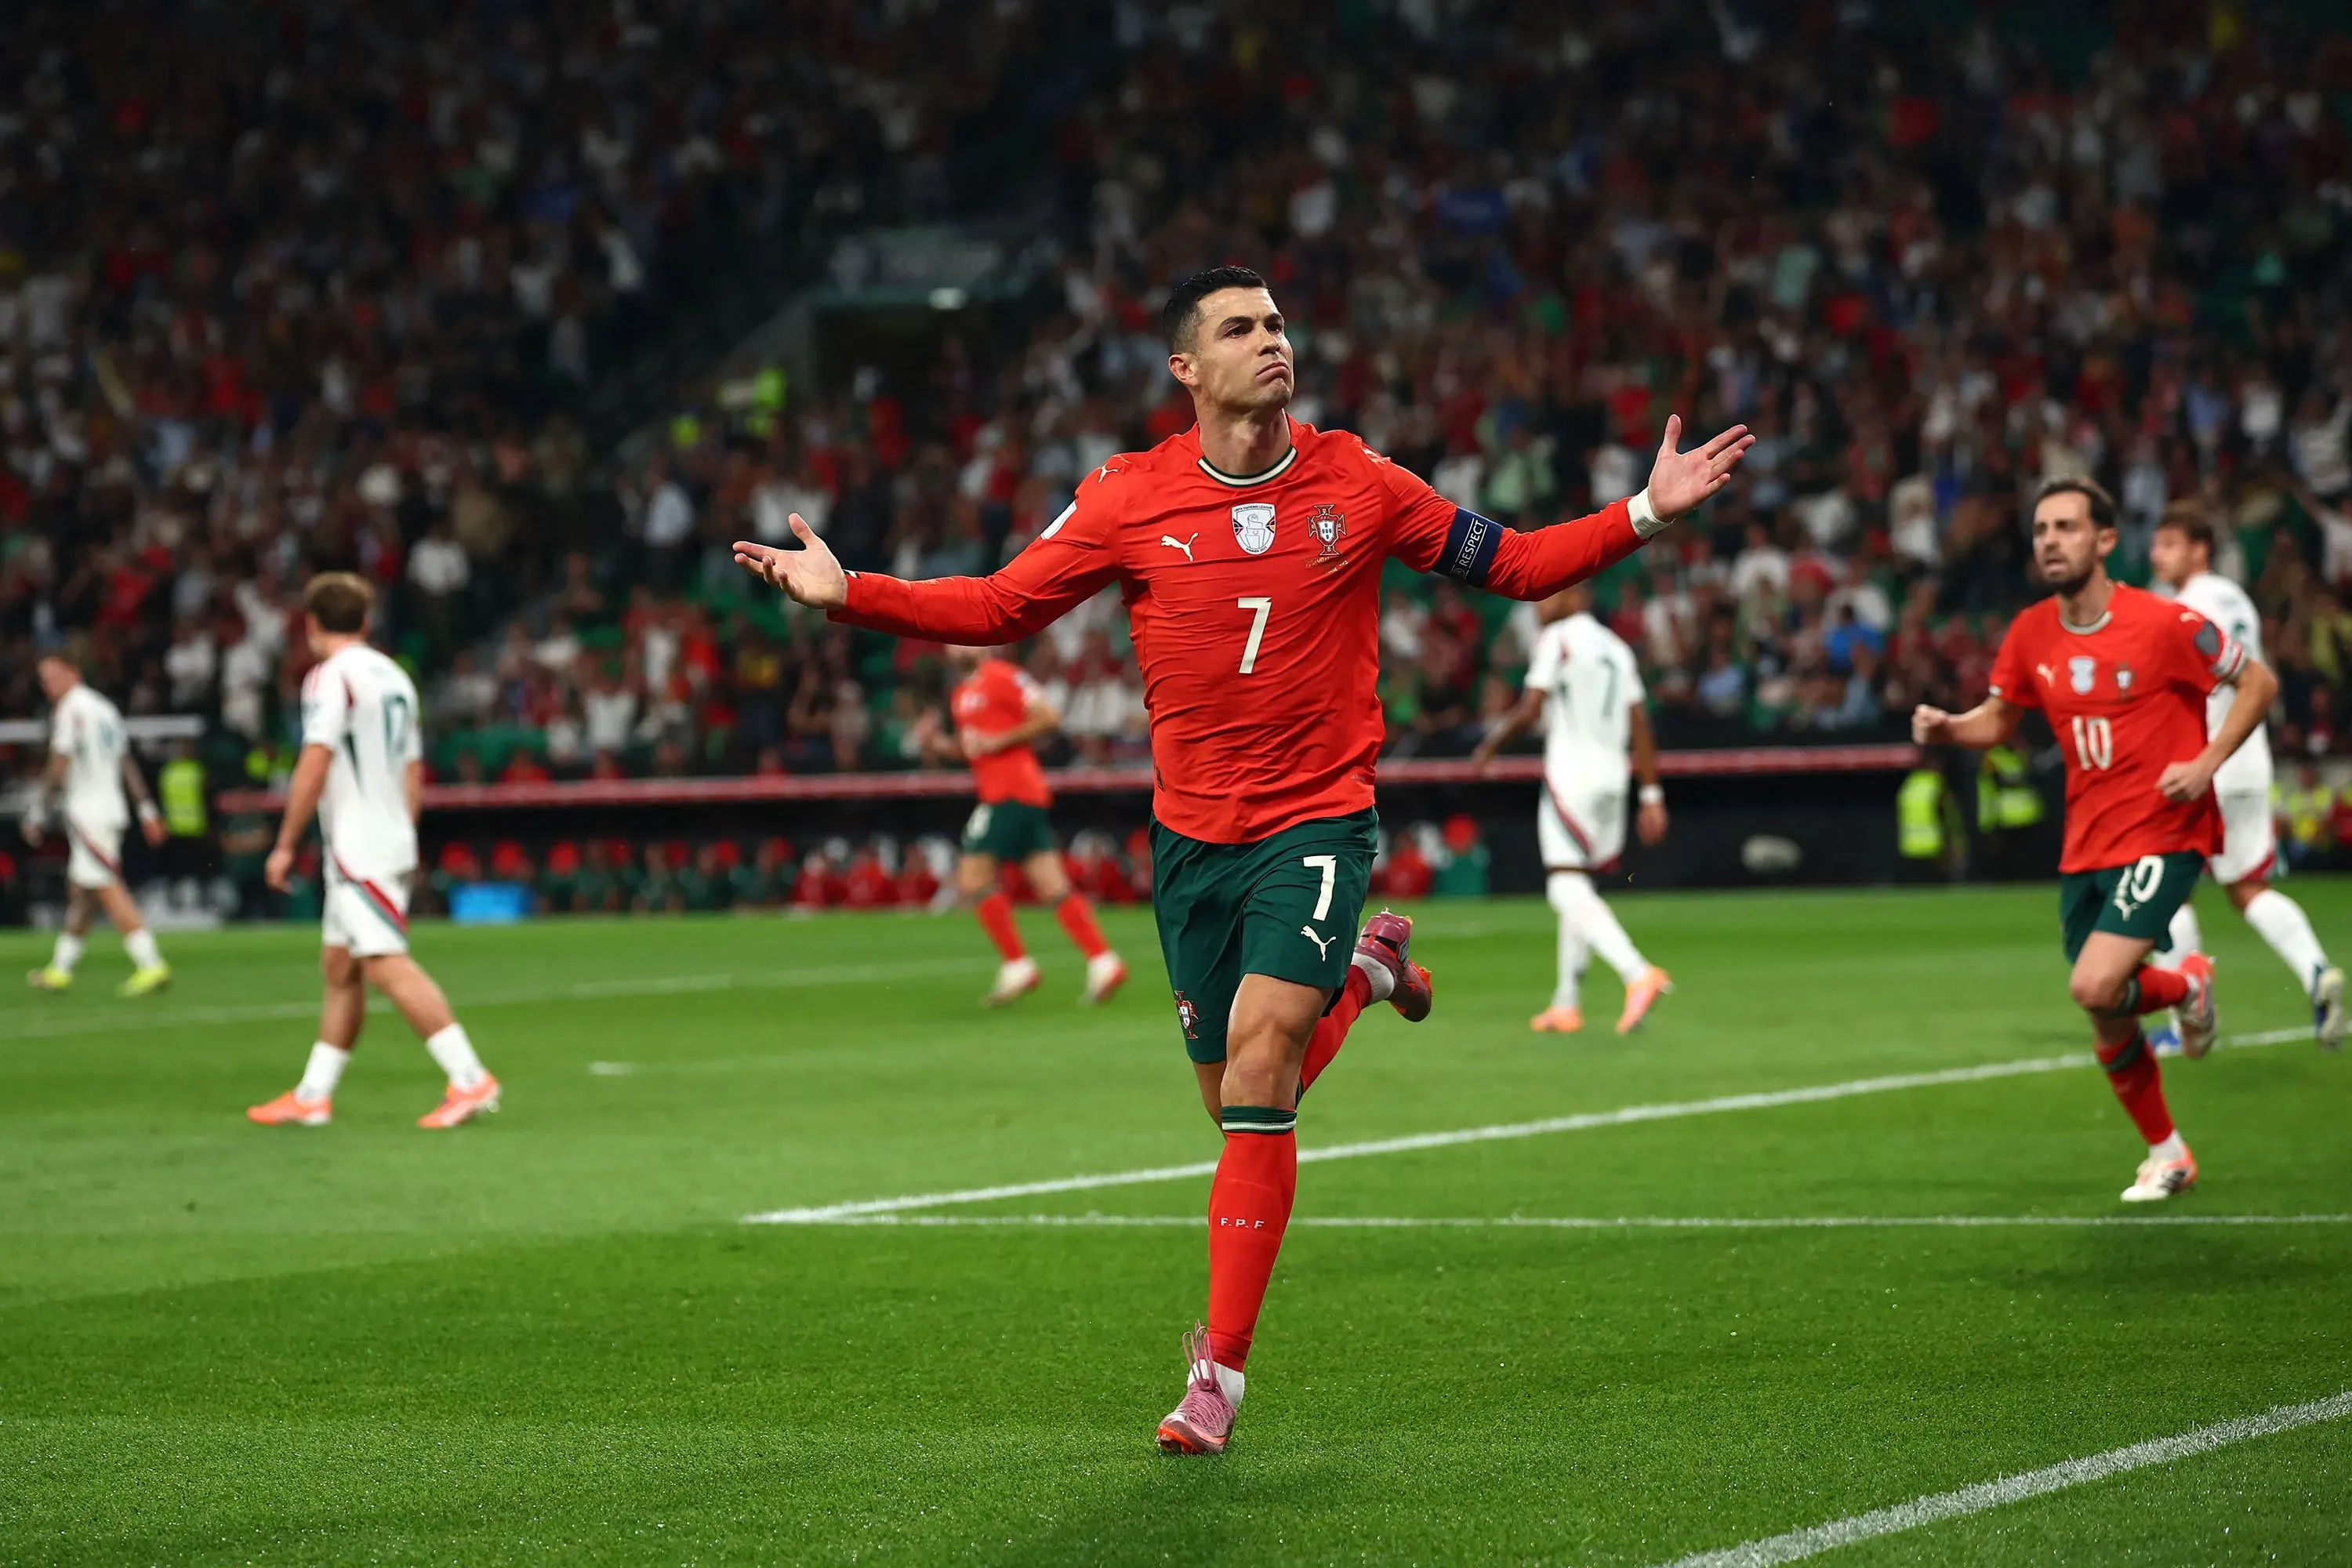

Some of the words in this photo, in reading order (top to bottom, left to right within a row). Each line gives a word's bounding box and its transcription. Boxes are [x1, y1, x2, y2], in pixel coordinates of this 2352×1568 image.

[1460, 520, 1484, 566] RESPECT
[1238, 597, 1272, 674] 7
[2072, 715, 2112, 771] 10
[1303, 855, 1337, 921] 7
